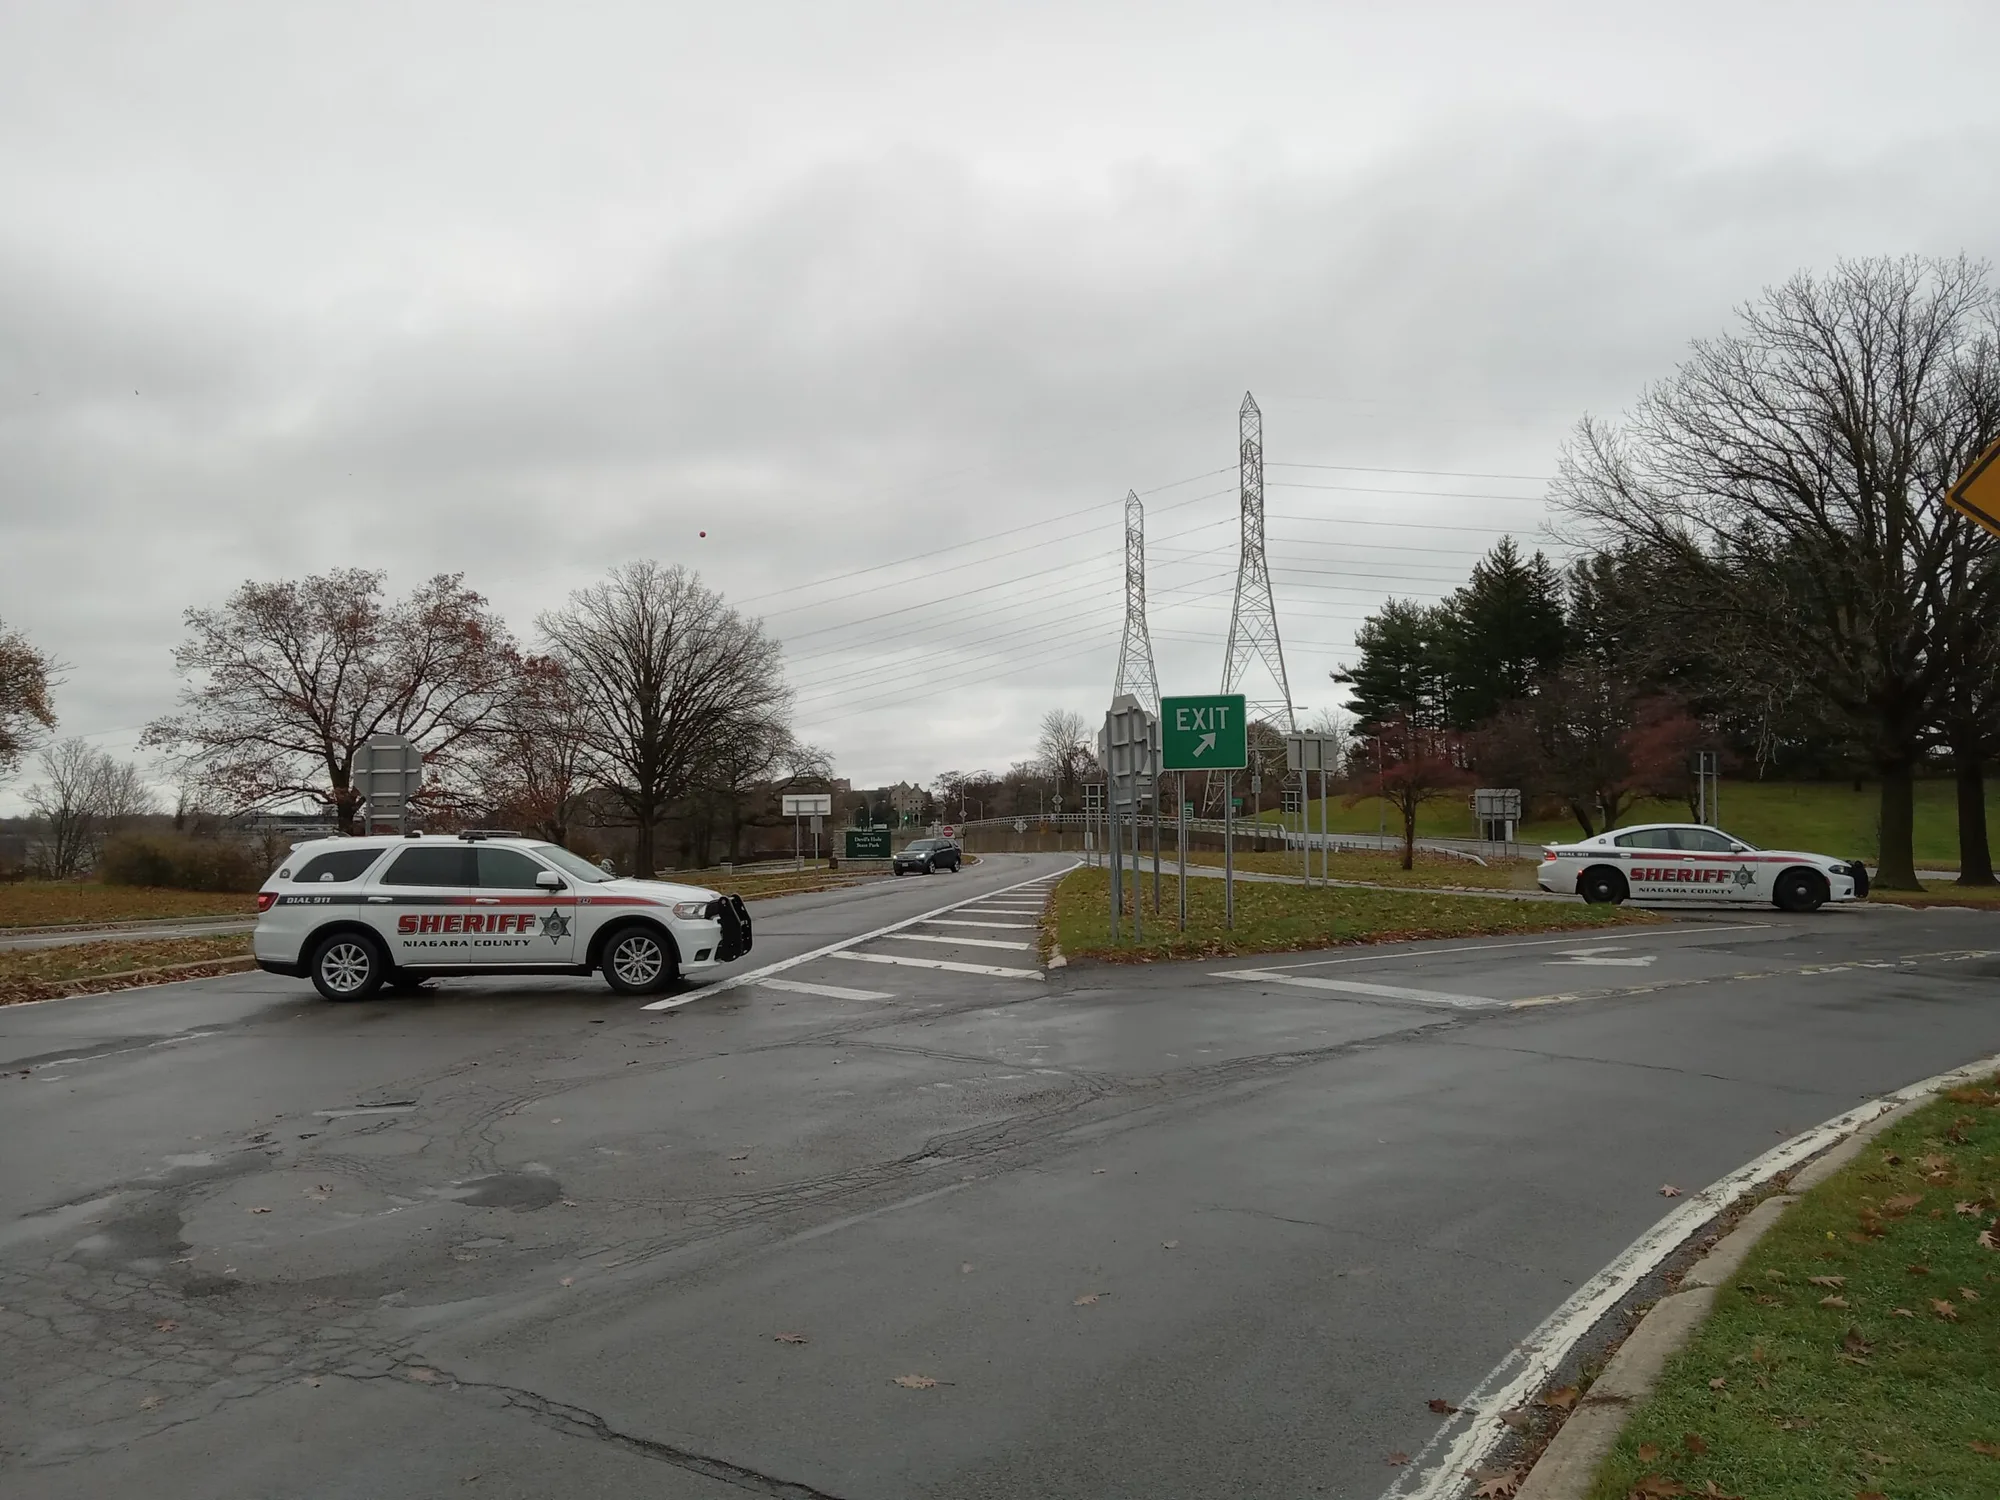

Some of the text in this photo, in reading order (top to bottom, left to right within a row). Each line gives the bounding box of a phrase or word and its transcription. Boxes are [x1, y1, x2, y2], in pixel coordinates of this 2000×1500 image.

[1176, 706, 1230, 731] EXIT
[1629, 867, 1734, 883] SHERIFF
[397, 913, 537, 935] SHERIFF
[402, 939, 531, 948] NIAGARA COUNTY
